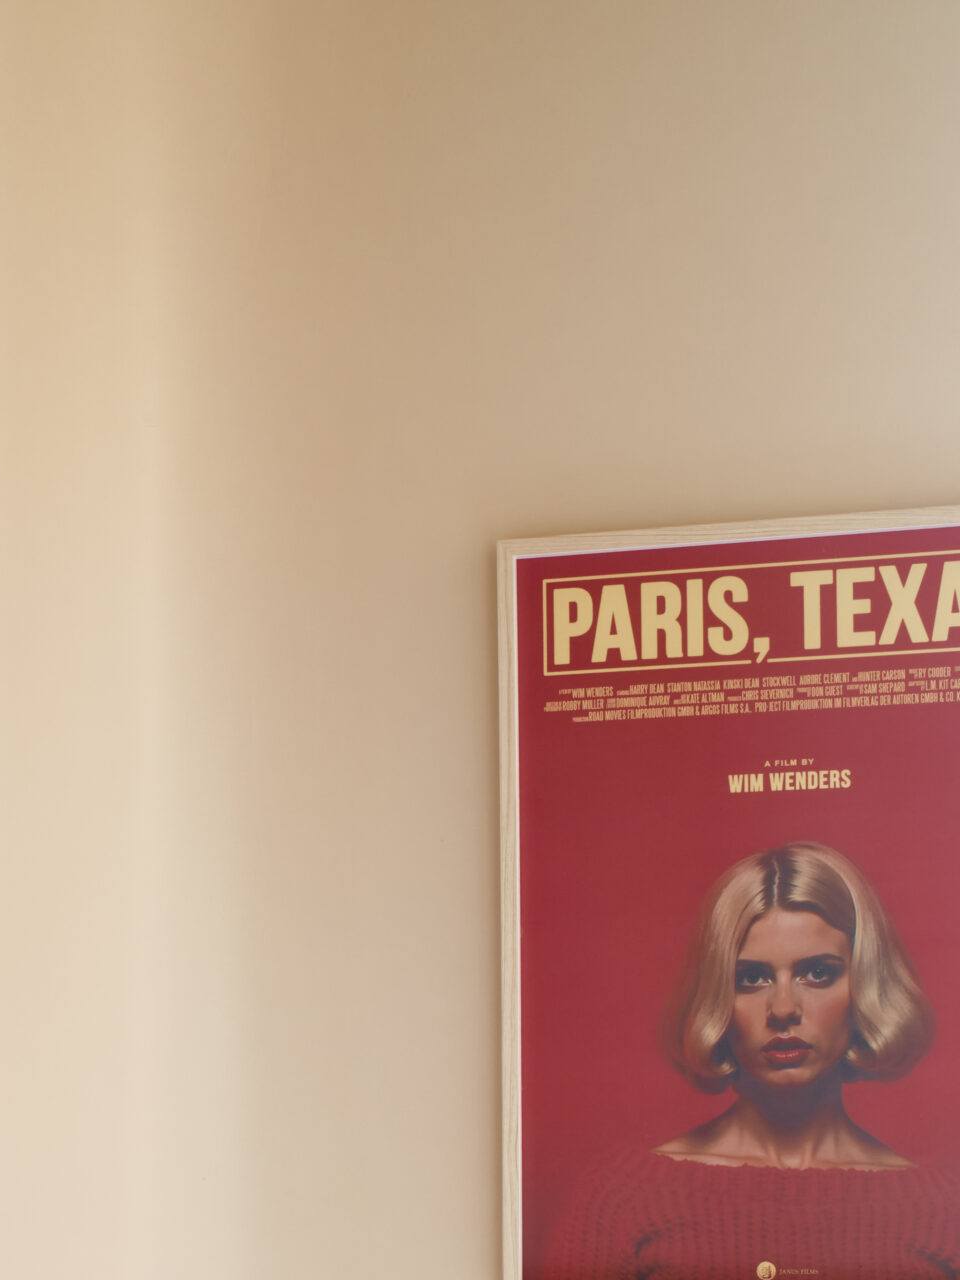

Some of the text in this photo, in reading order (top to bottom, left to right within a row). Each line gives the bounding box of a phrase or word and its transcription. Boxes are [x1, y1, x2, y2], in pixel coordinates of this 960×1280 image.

[553, 560, 960, 666] PARIS, TEXA
[572, 688, 585, 698] WIM
[586, 686, 613, 698] WENDERS
[649, 683, 665, 694] DEAN
[744, 677, 759, 689] DEAN
[762, 675, 796, 688] STOCKWELL
[858, 670, 880, 682] HUNTER
[881, 669, 906, 681] CARSON
[928, 667, 951, 678] COODER
[686, 693, 700, 704] KATE
[701, 691, 725, 703] ALTMAN
[741, 690, 759, 701] CHRIS
[825, 684, 843, 696] GUEST
[863, 683, 878, 694] SAM
[879, 681, 906, 693] SHEPARD
[588, 711, 604, 721] ROAD
[605, 709, 627, 720] MOVIES
[701, 704, 720, 715] ARGOS
[721, 703, 739, 715] FILMS
[842, 695, 879, 708] FILMVERLAG
[892, 693, 920, 705] AUTOREN
[774, 759, 797, 767] FILM
[801, 758, 814, 766] BY
[728, 769, 851, 793] WIM WENDERS
